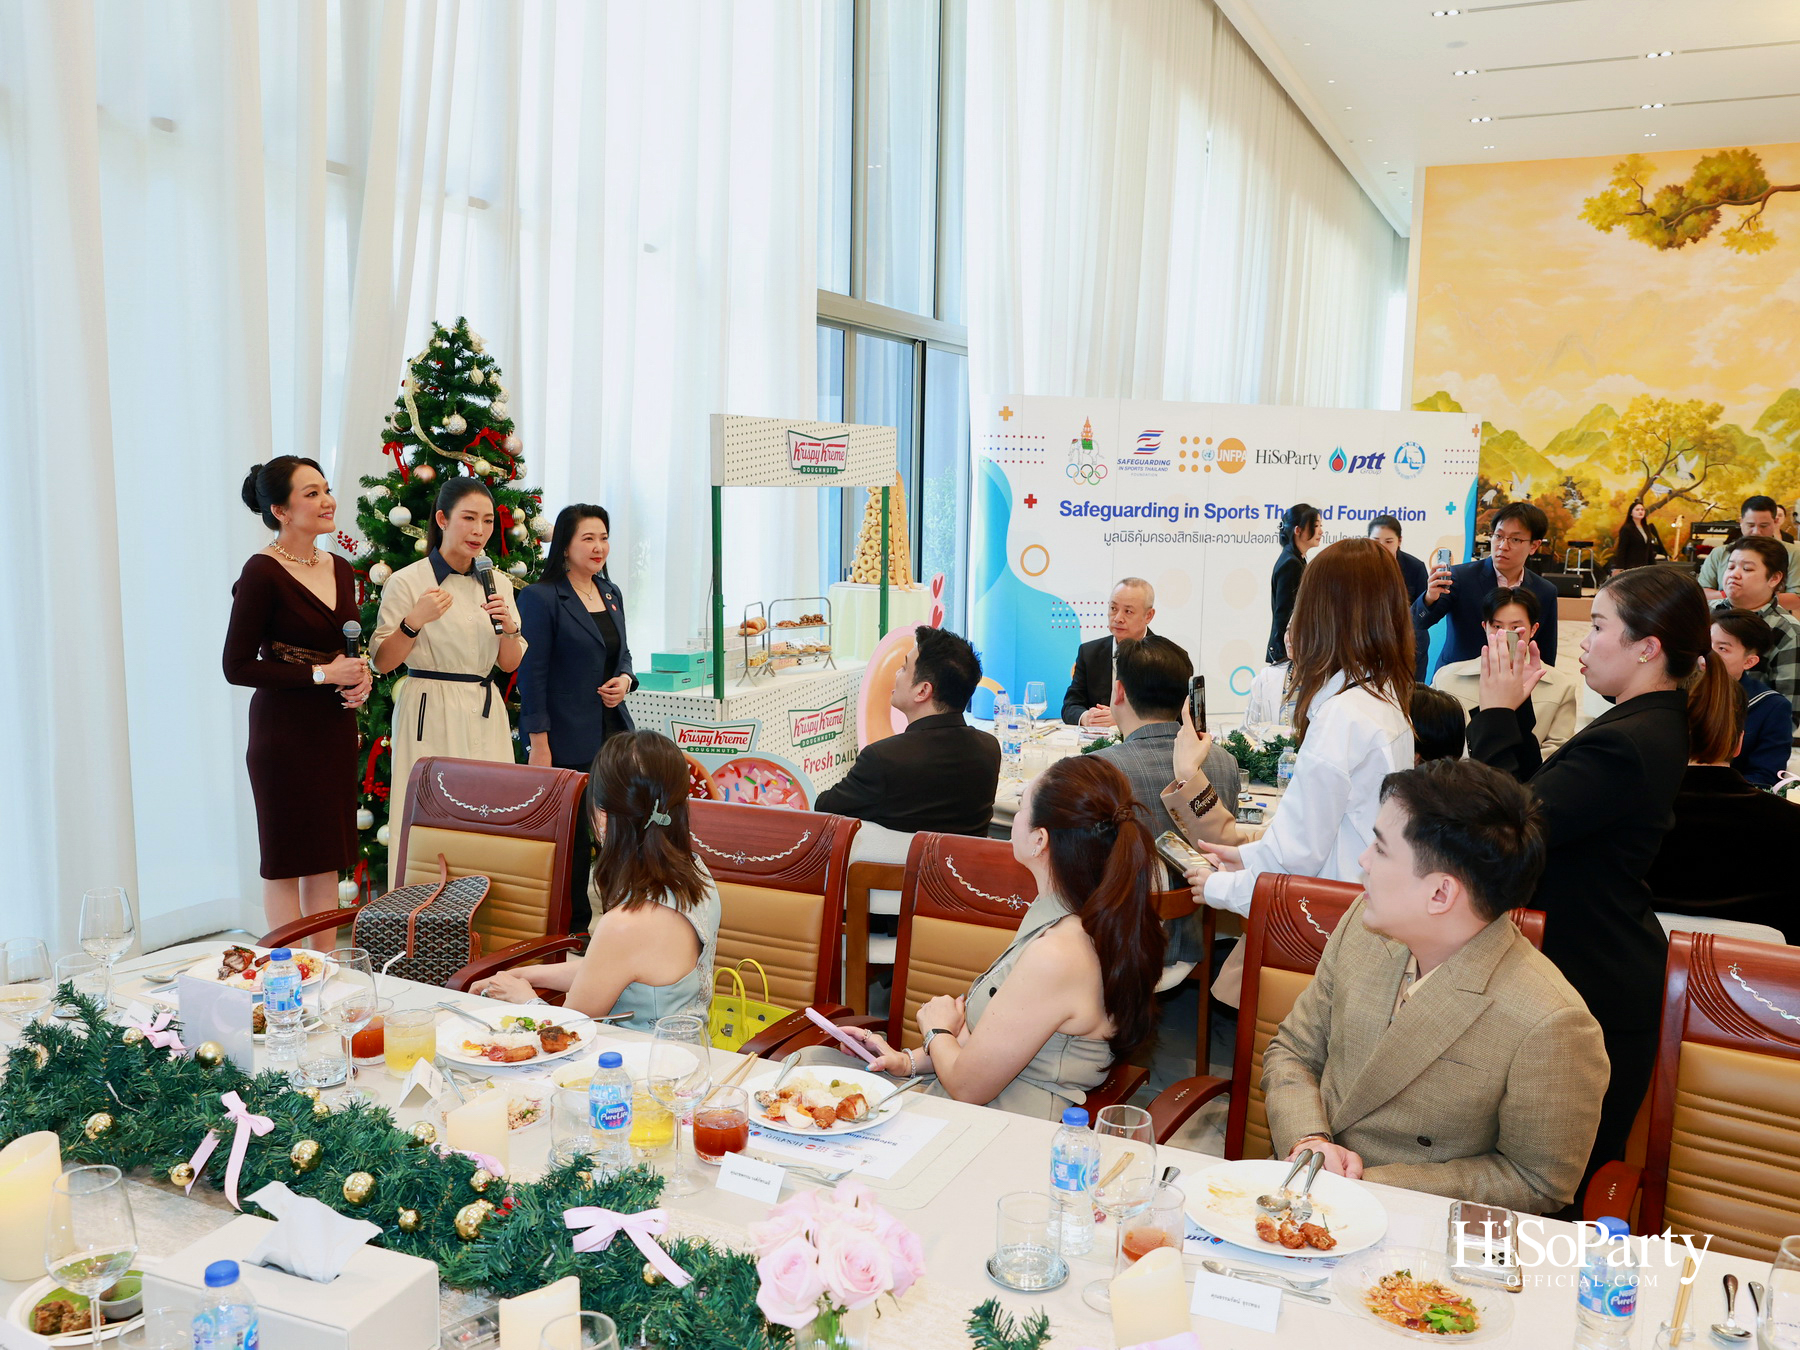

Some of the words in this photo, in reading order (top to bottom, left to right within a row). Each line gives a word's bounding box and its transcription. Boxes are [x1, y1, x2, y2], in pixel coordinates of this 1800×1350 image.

[793, 441, 821, 465] Krispy
[820, 442, 846, 462] Kreme
[1117, 458, 1171, 466] SAFEGUARDING
[1256, 449, 1322, 470] HiSoParty
[1348, 452, 1386, 473] ptt
[1360, 468, 1382, 476] Group
[1059, 500, 1180, 522] Safeguarding
[1184, 503, 1199, 518] in
[1204, 503, 1259, 523] Sports
[1338, 505, 1427, 521] Foundation
[793, 713, 820, 738] Krispy
[819, 707, 844, 730] Kreme
[678, 729, 715, 746] Krispy
[713, 730, 750, 745] Kreme
[803, 751, 833, 774] Fresh
[836, 747, 859, 766] DAILY
